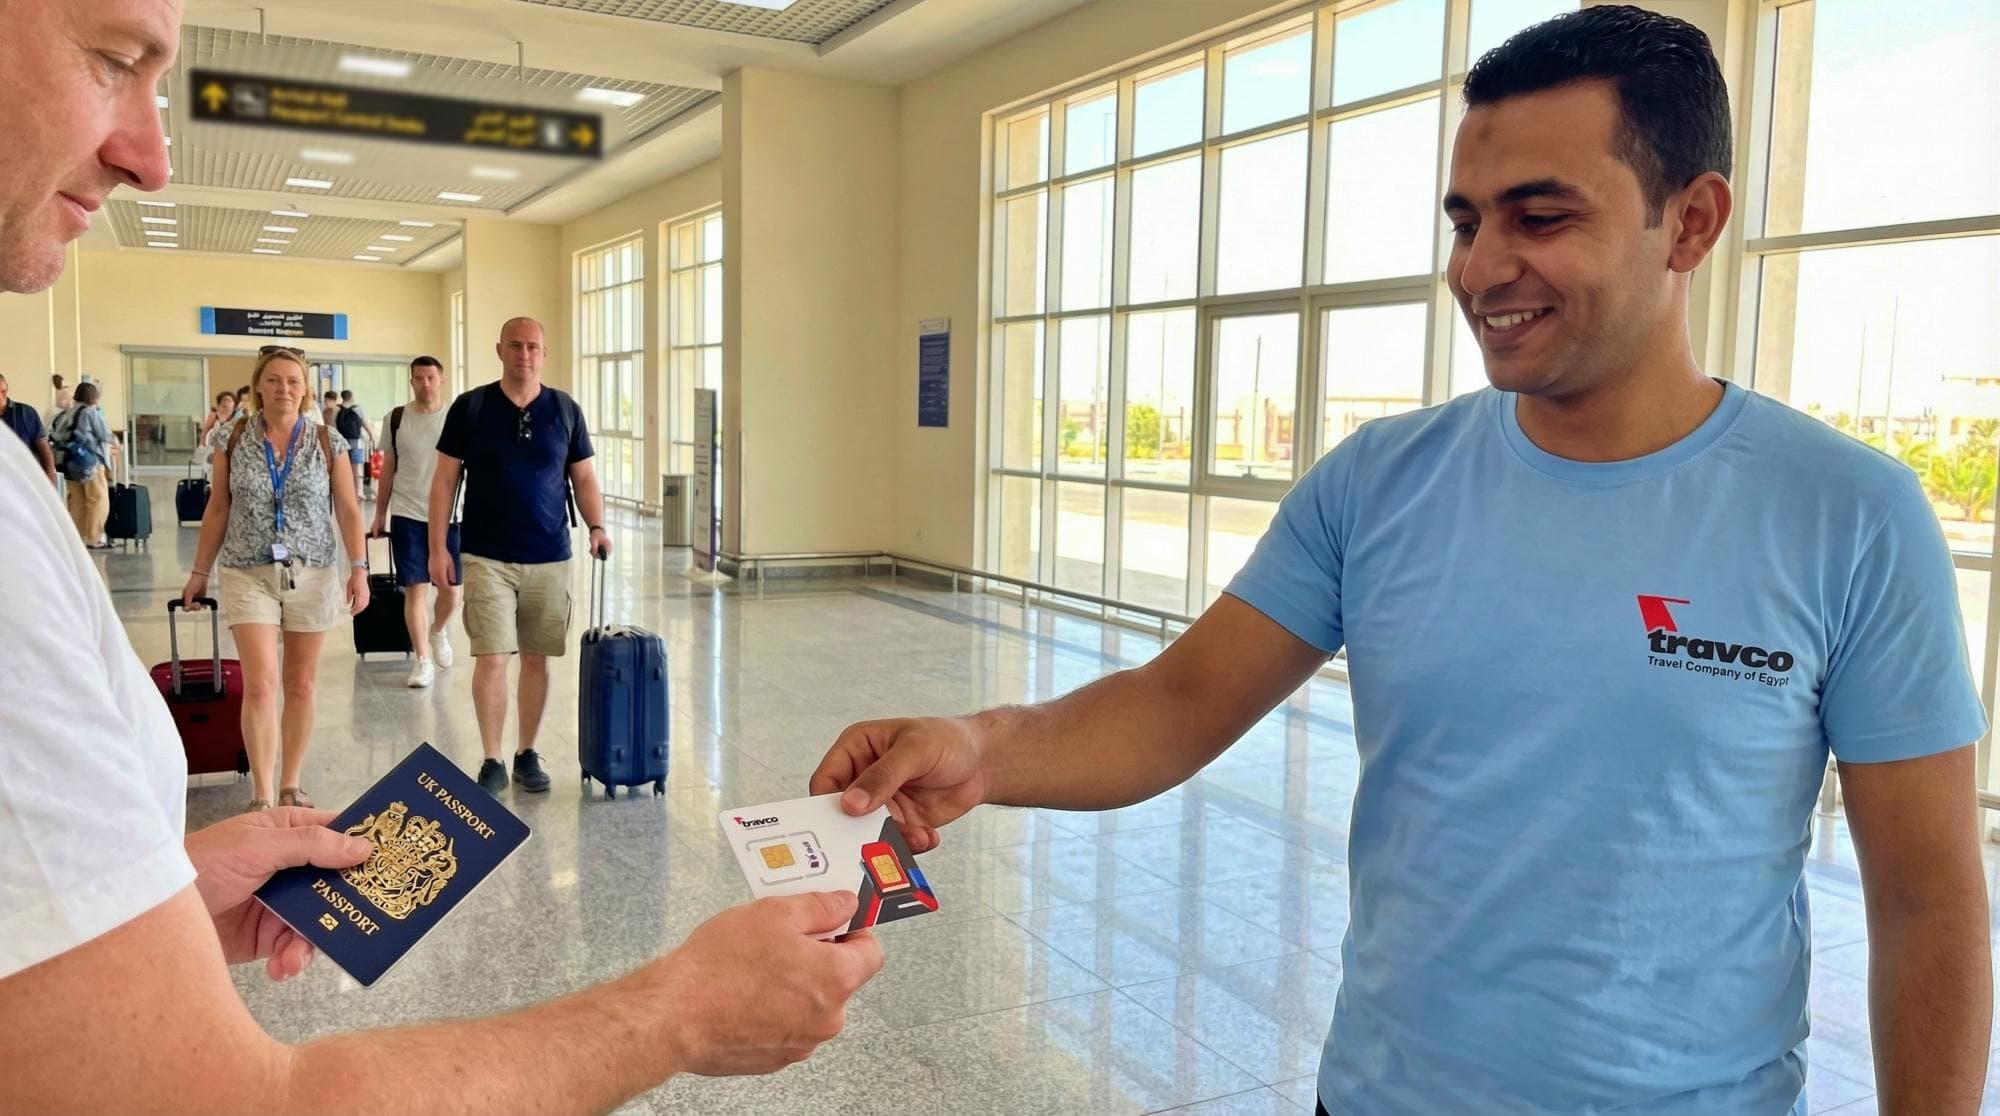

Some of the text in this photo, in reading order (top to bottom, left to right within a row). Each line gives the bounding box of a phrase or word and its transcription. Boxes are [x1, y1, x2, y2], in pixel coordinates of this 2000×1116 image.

[1648, 629, 1794, 672] travco
[1648, 655, 1789, 688] Travel Company of Egypt
[417, 772, 495, 839] UK PASSPORT
[742, 816, 779, 828] travco
[312, 879, 380, 936] PASSPORT
